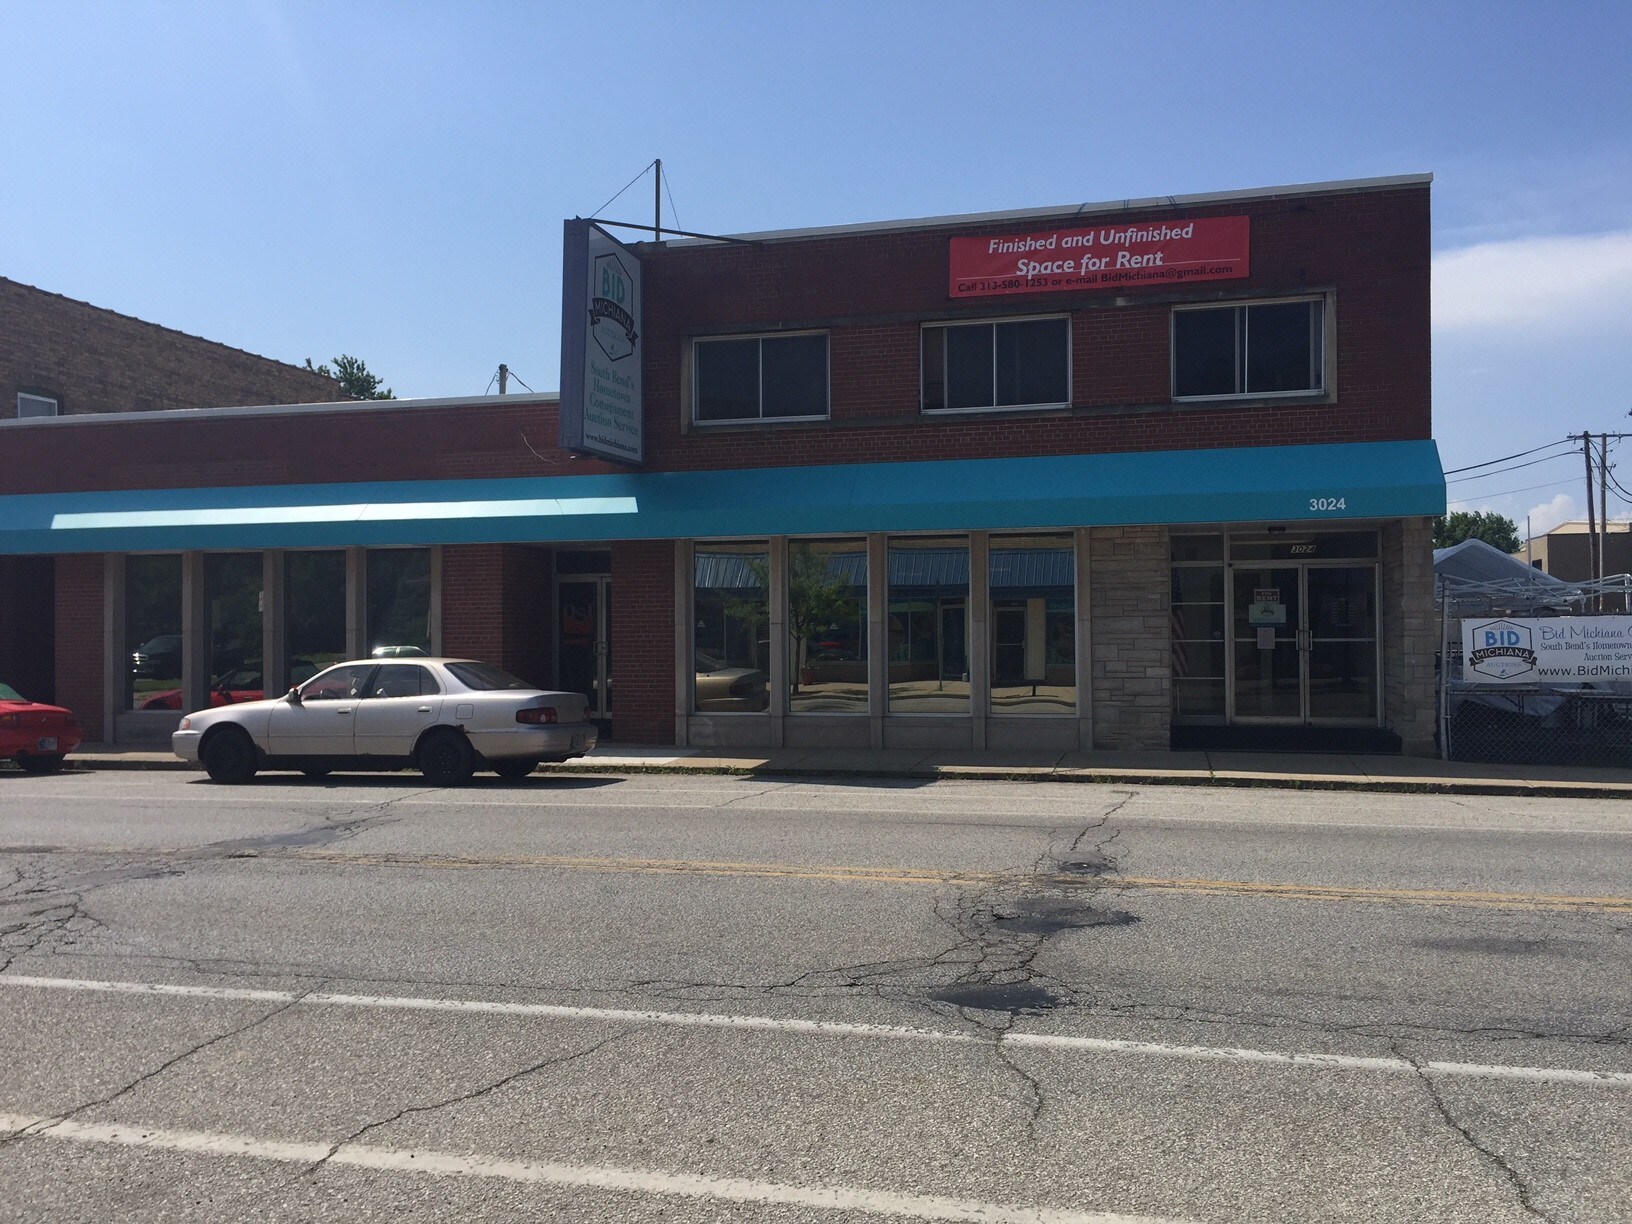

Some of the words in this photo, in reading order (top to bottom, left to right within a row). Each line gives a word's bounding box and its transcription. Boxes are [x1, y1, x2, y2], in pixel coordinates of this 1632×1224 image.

[988, 234, 1057, 253] Finished
[1061, 231, 1095, 247] and
[1099, 223, 1194, 247] Unfinished
[958, 283, 977, 292] Call
[980, 277, 1048, 291] 313-580-1253
[1065, 275, 1098, 285] e-mail
[1100, 265, 1233, 282] BidMichiana@gmail.com
[1016, 258, 1075, 280] Space
[1080, 254, 1110, 275] for
[1116, 251, 1164, 269] Rent
[602, 266, 625, 304] BID
[594, 300, 634, 333] MICHIANA
[591, 361, 610, 380] South
[612, 369, 635, 390] Bend's
[593, 377, 631, 404] Hometown
[589, 392, 635, 420] Consignment
[585, 407, 612, 428] Auction
[613, 418, 639, 436] Service
[1309, 498, 1346, 511] 3024
[1485, 631, 1520, 647] BID
[1539, 626, 1566, 641] Bid
[1570, 625, 1624, 639] Michiana
[1541, 642, 1563, 651] South
[1565, 641, 1591, 650] Bend's
[1592, 641, 1632, 650] Hometown
[1475, 648, 1530, 659] MICHIANA
[1584, 653, 1613, 661] Auction
